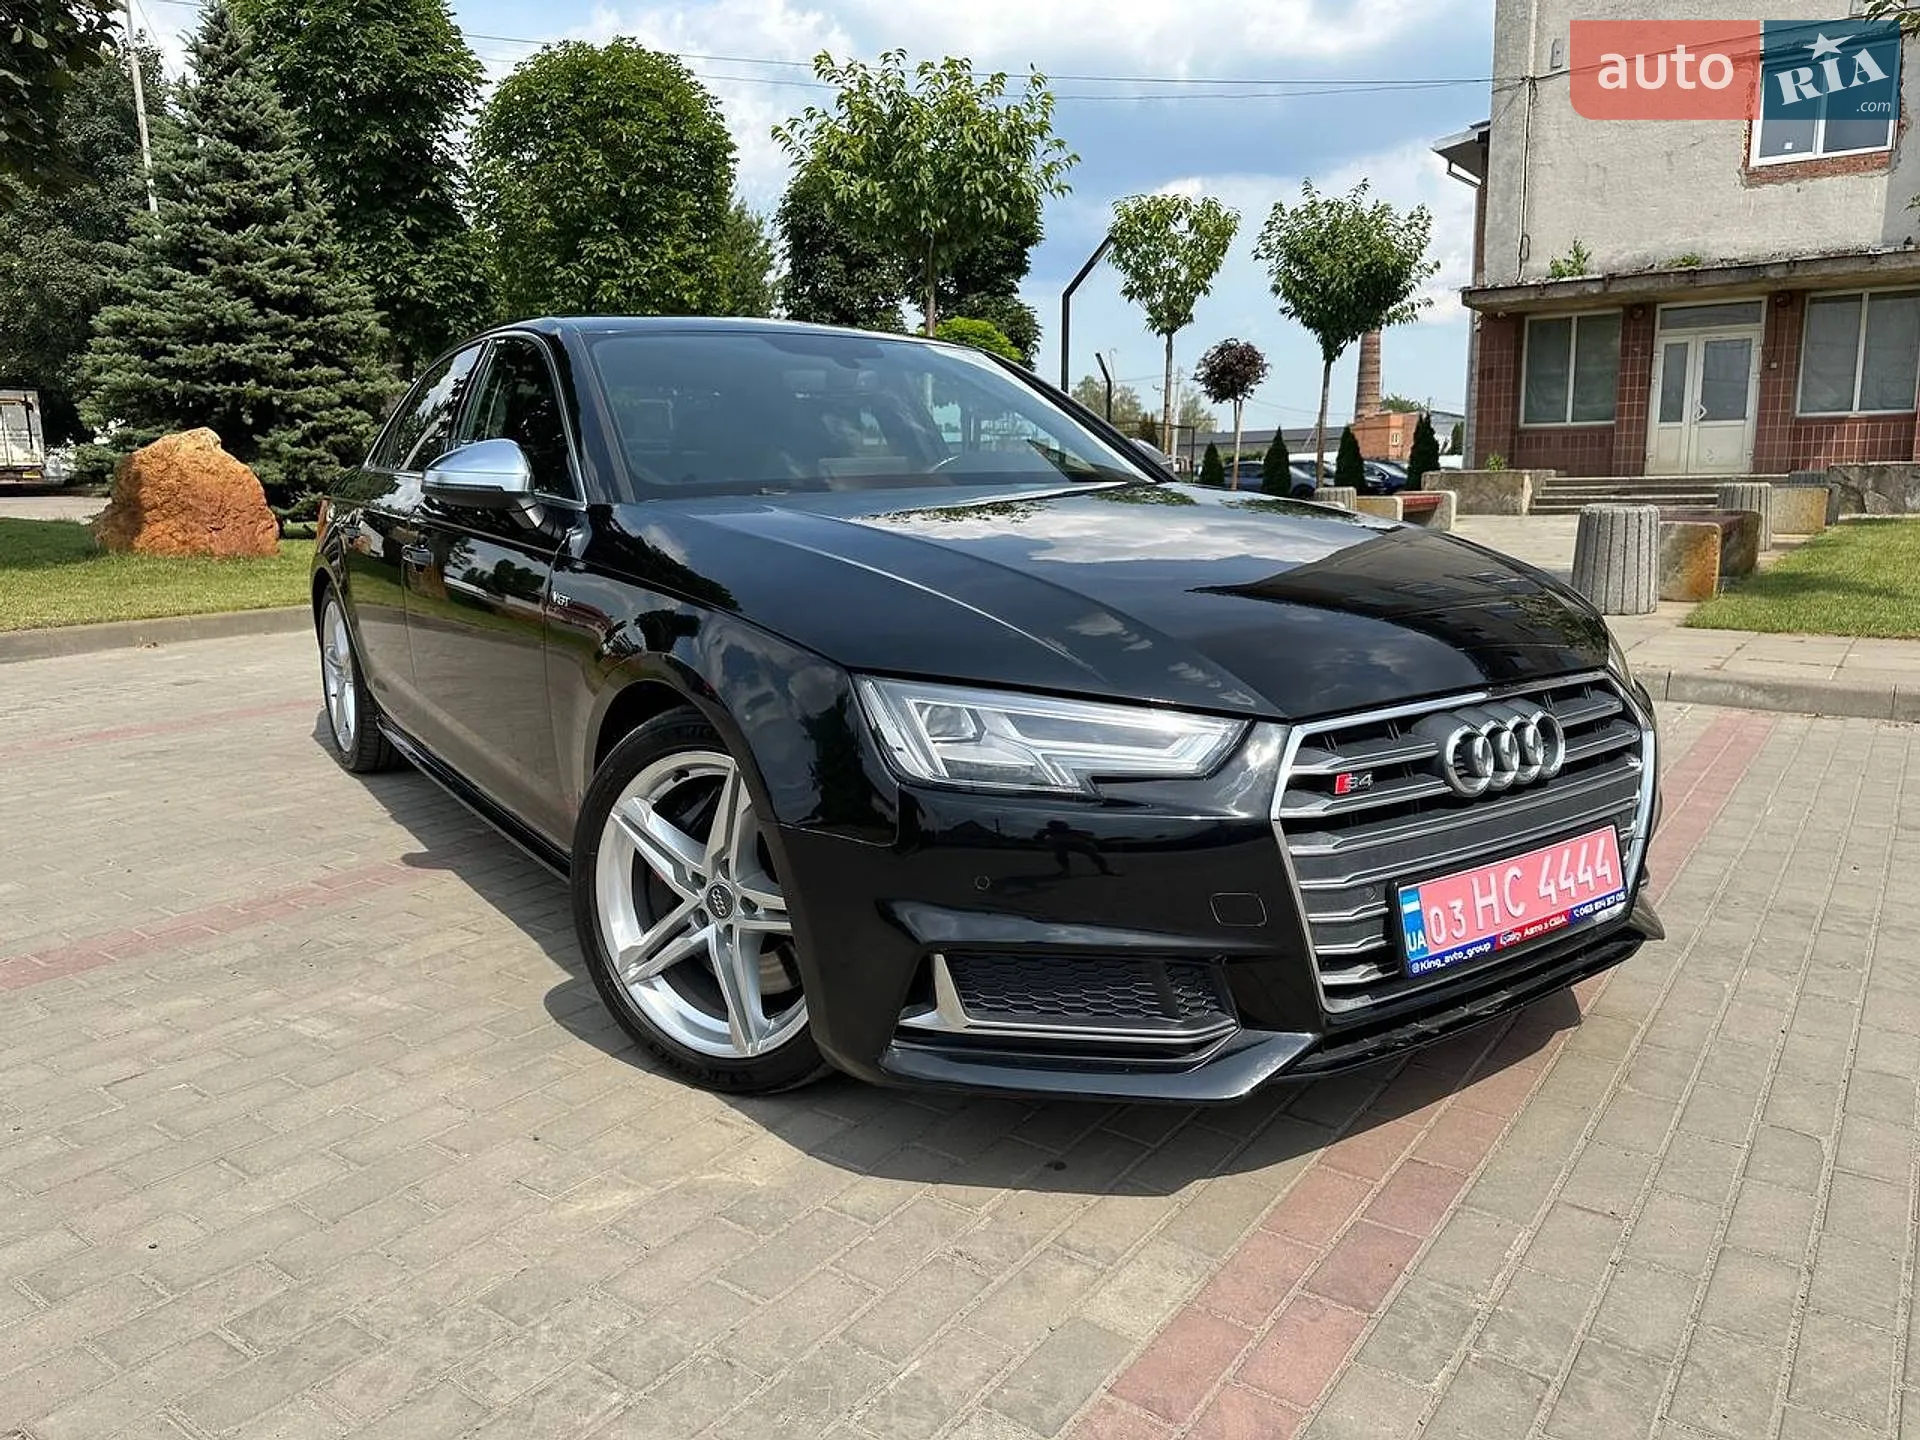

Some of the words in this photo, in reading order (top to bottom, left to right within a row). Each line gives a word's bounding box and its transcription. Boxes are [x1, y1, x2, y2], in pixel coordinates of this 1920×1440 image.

[1429, 899, 1467, 945] 03
[1472, 867, 1526, 931] HC
[1538, 836, 1614, 905] 4444
[1406, 930, 1427, 951] UA
